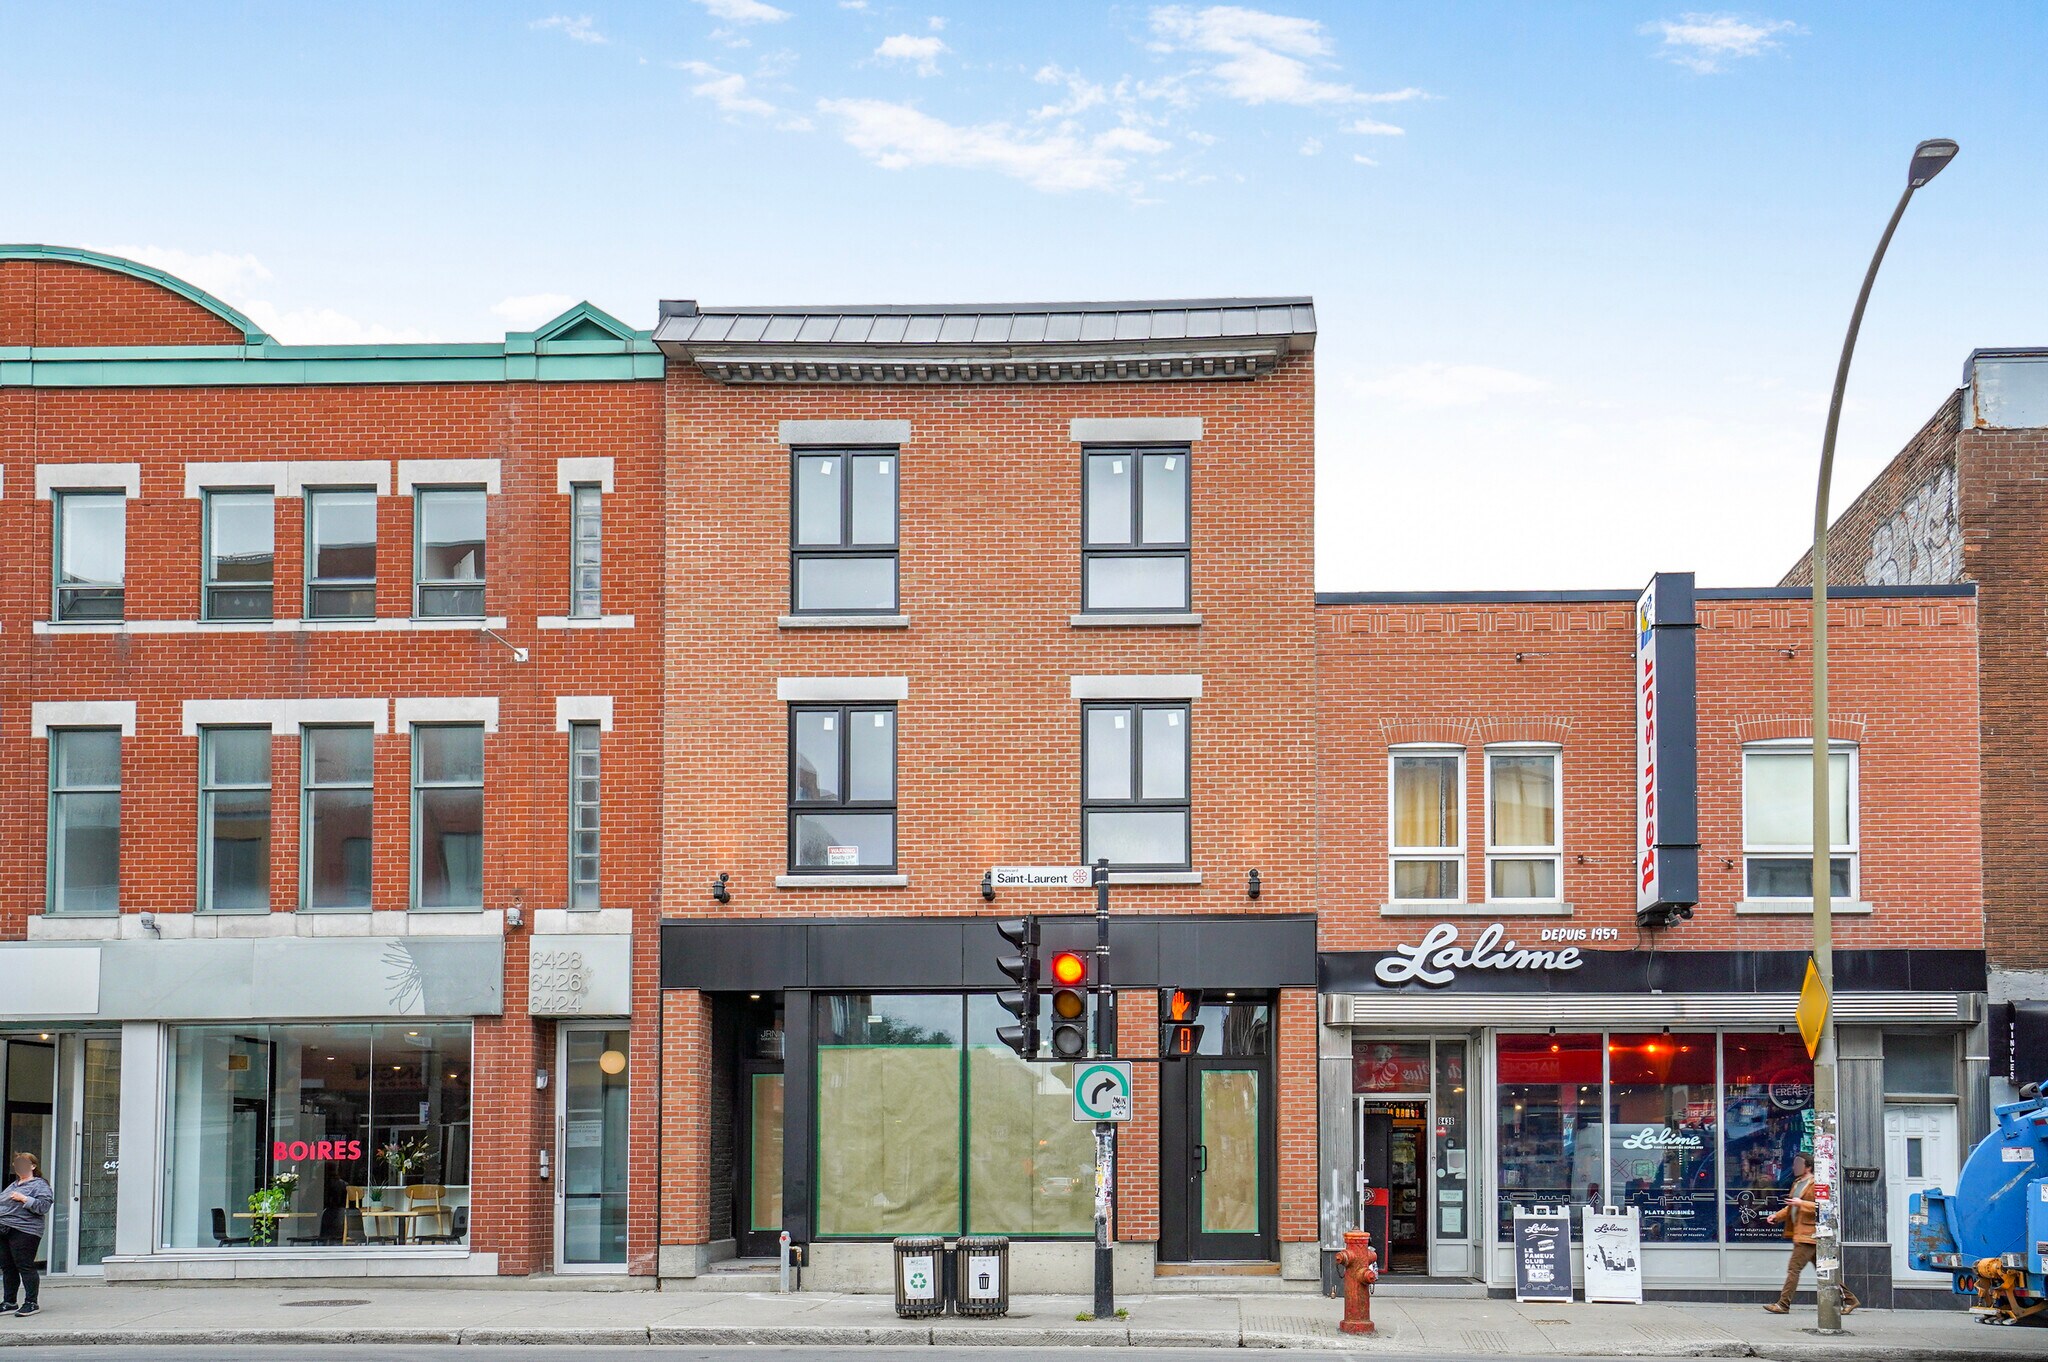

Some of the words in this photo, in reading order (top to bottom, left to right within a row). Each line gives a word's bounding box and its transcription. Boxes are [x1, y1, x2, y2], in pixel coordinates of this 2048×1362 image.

[1640, 658, 1655, 896] Beau-soir
[997, 873, 1068, 883] Saint-Laurent
[1541, 929, 1587, 942] DEPUIS
[1591, 928, 1618, 941] 1959
[531, 952, 582, 970] 6428
[1374, 923, 1583, 984] Lalime
[531, 974, 582, 992] 6426
[530, 995, 582, 1013] 6424
[1181, 1028, 1190, 1052] 0
[1623, 1128, 1701, 1150] Lalime
[274, 1140, 361, 1161] BOIRES
[1525, 1223, 1559, 1233] Lalime
[1594, 1224, 1628, 1233] Lalime
